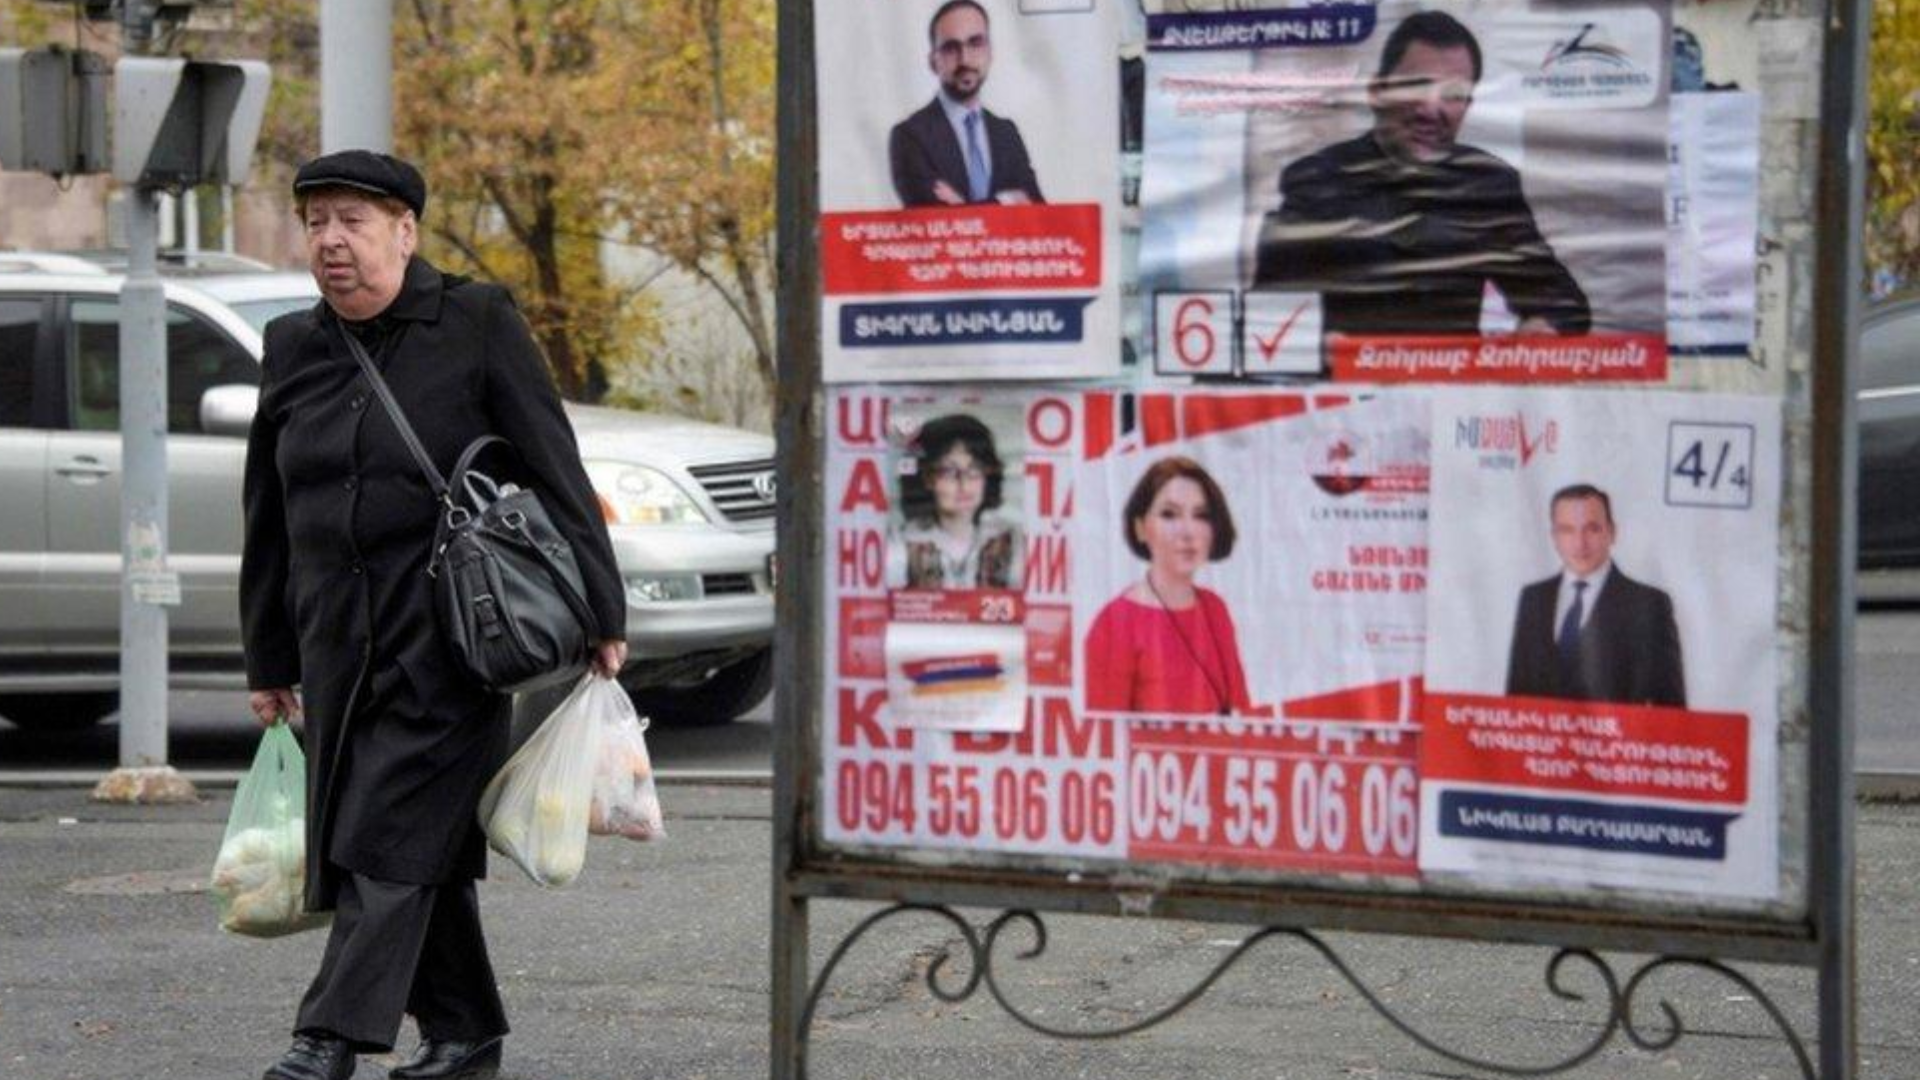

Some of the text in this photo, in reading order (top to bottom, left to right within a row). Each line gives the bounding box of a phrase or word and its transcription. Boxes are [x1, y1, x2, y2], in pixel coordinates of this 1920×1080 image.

[854, 309, 1065, 338] ՏԻԳՐԱՆ ԱՎԻՆՅԱՆ
[1172, 299, 1214, 366] 6
[838, 759, 1115, 844] 094 55 06 06
[1131, 752, 1417, 859] 094 55 06 06
